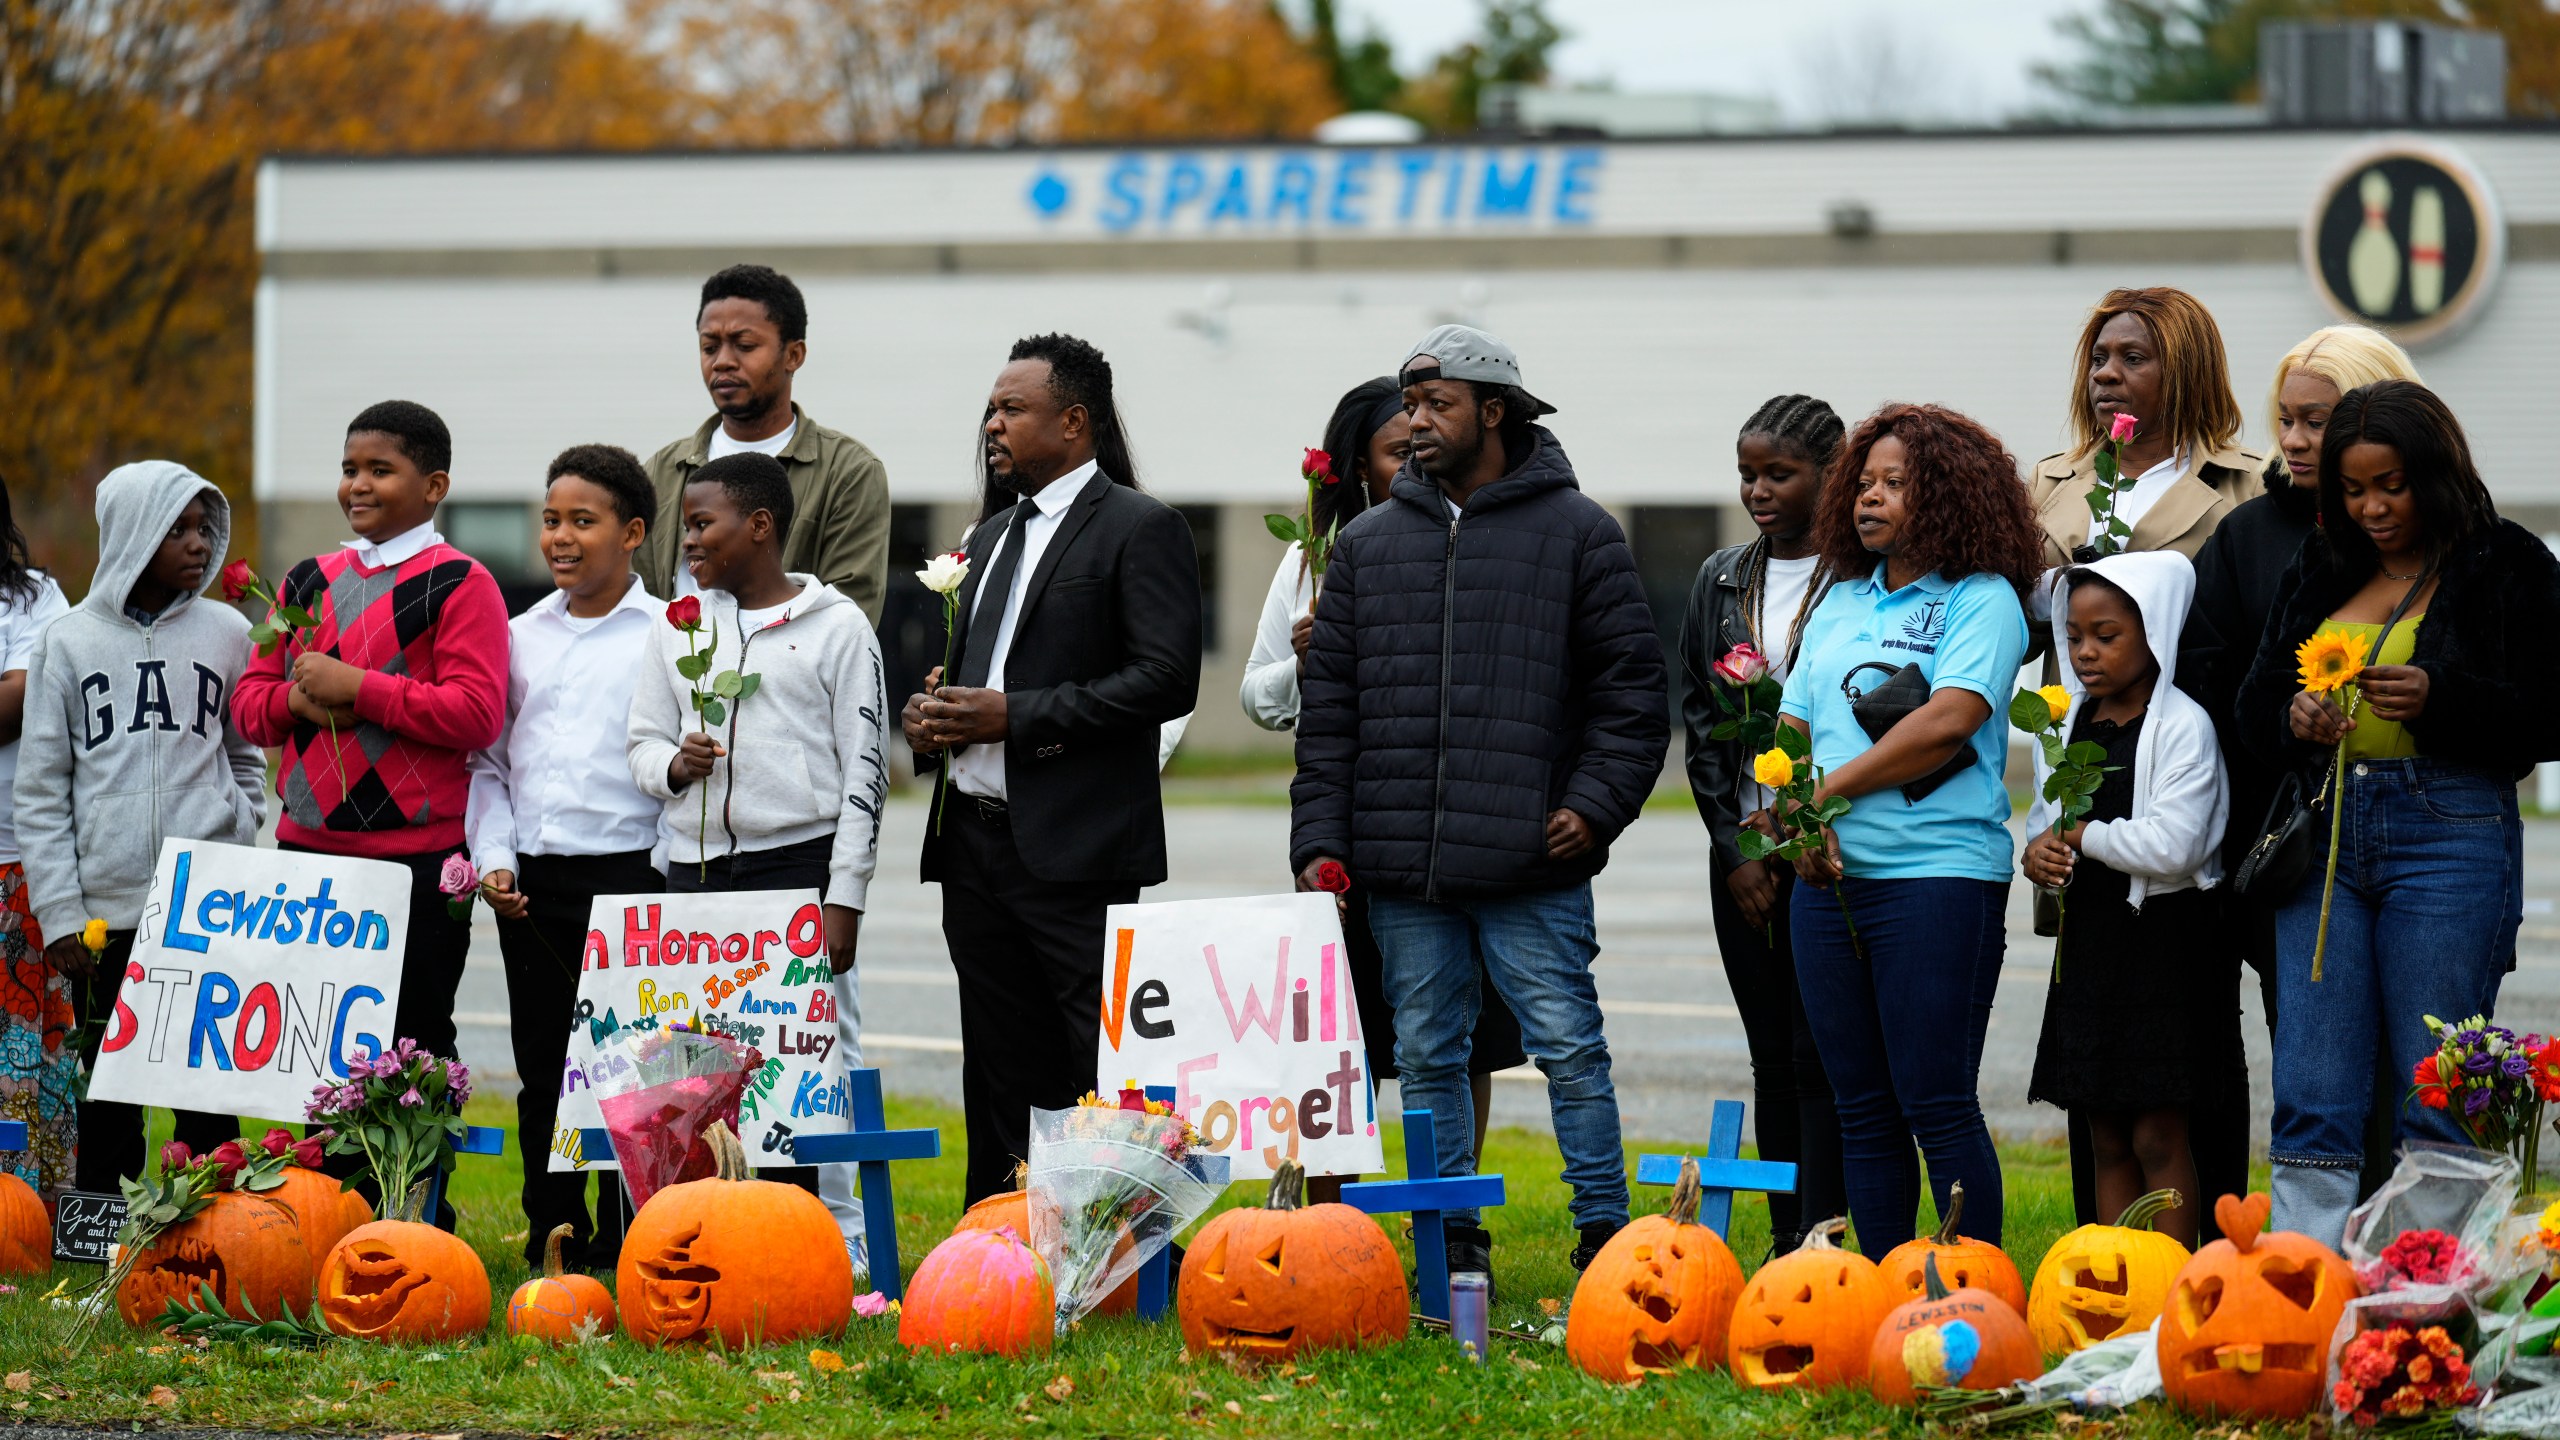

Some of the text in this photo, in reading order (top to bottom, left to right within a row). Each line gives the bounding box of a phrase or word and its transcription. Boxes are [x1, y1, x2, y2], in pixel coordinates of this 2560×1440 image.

[80, 659, 224, 752] GAP
[583, 903, 828, 971] n Honor O
[638, 979, 689, 1016] Ron
[703, 960, 770, 1009] Jason
[738, 989, 797, 1015] Aaron
[1203, 936, 1360, 1044] Will
[101, 960, 387, 1080] STRONG
[806, 989, 837, 1023] Bill
[778, 1024, 836, 1065] Lucy
[790, 1070, 849, 1120] Keith
[1176, 1049, 1376, 1171] Forget!
[762, 1121, 795, 1158] Jo
[61, 1199, 108, 1235] God
[110, 1203, 125, 1213] has
[87, 1228, 105, 1237] and
[109, 1217, 129, 1227] in hi
[74, 1239, 83, 1249] in
[84, 1243, 98, 1254] my
[1896, 1302, 1985, 1331] LEWISTON
